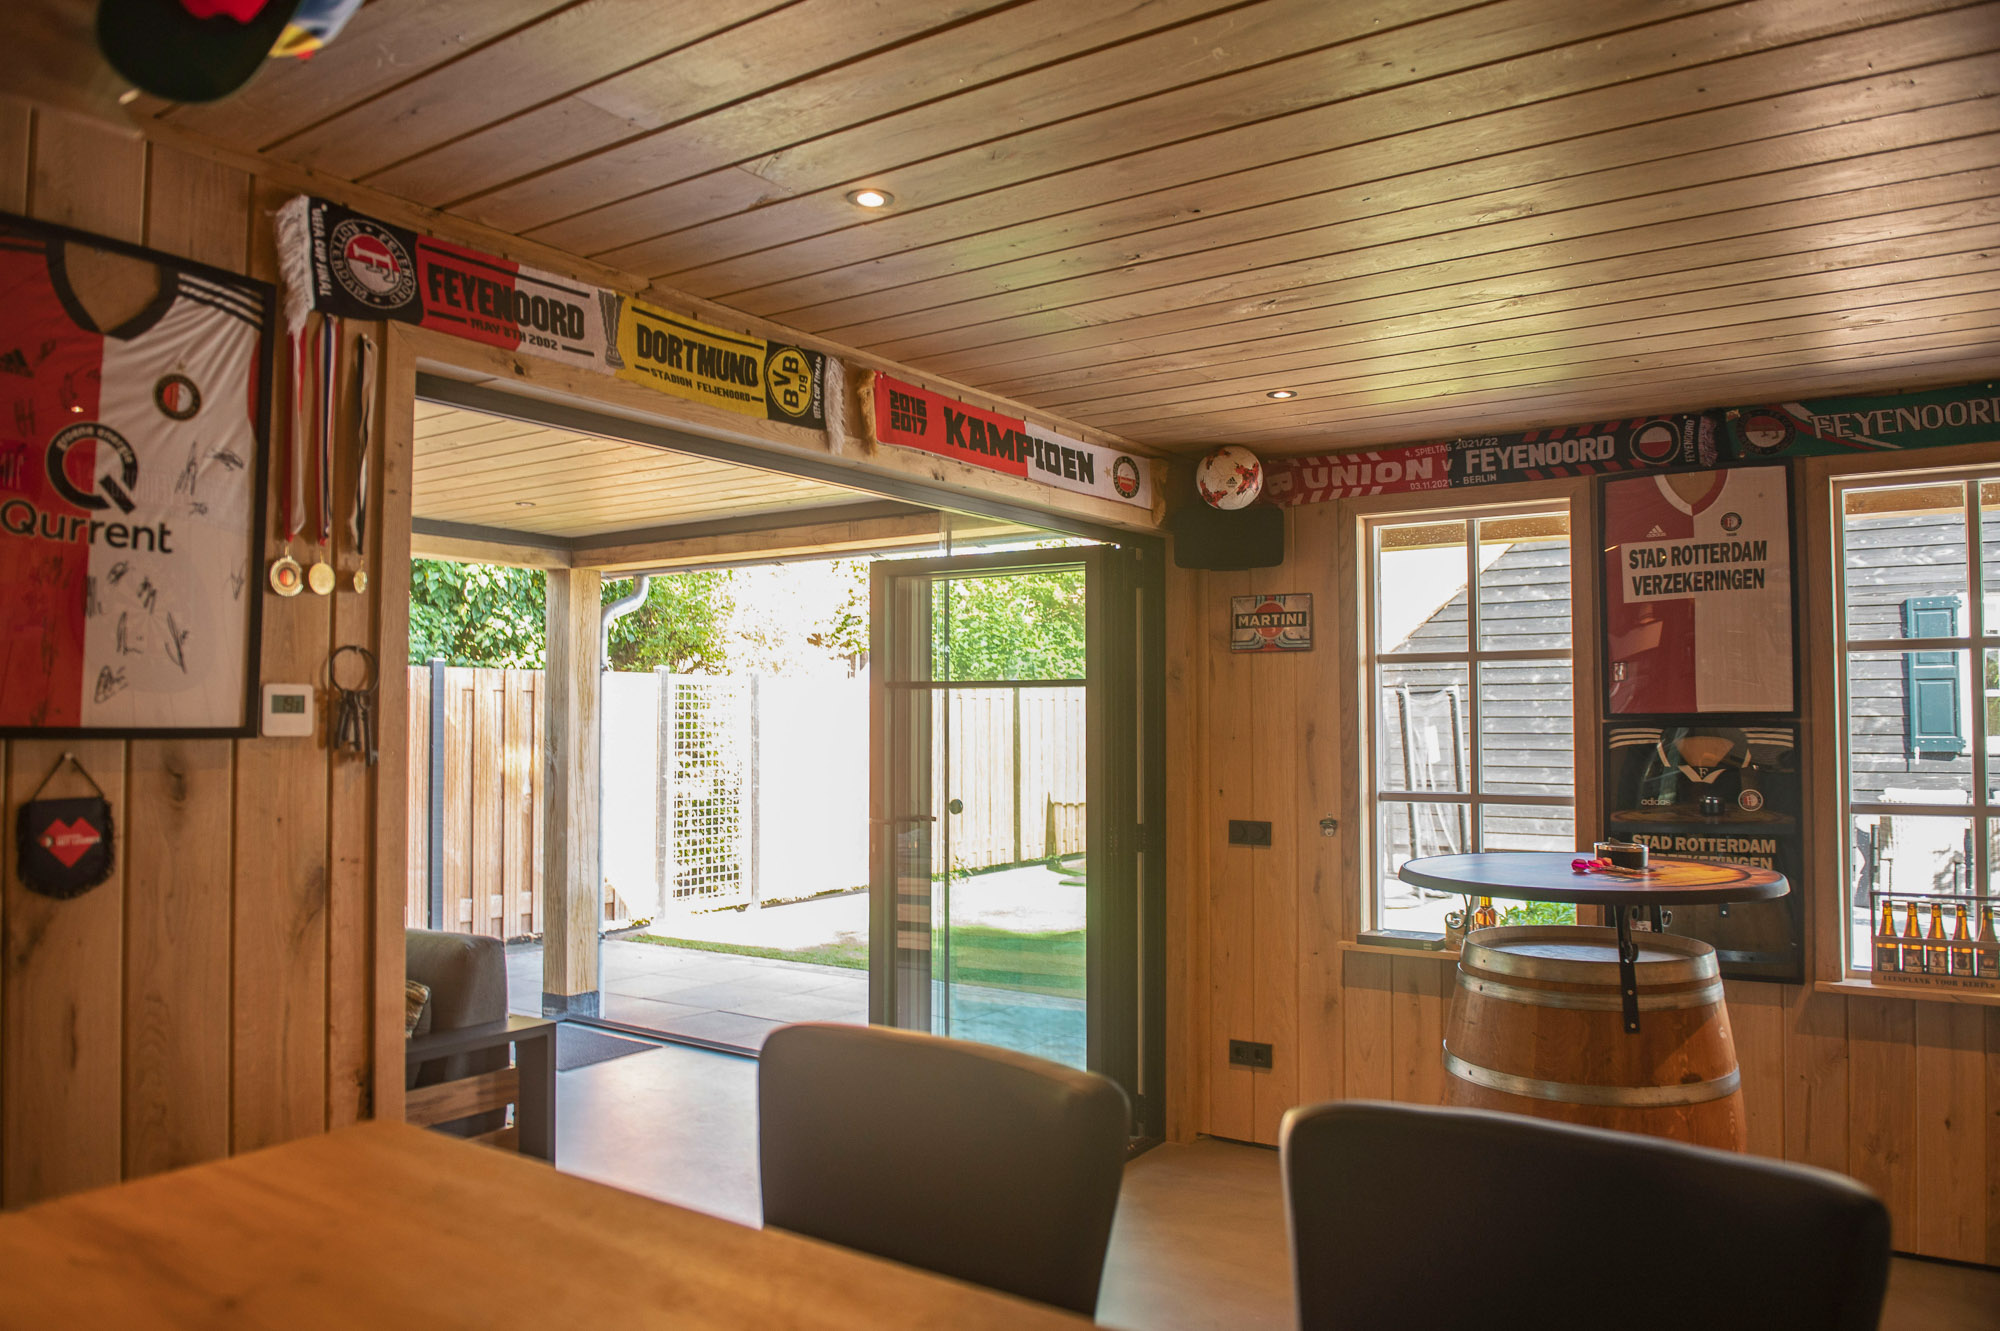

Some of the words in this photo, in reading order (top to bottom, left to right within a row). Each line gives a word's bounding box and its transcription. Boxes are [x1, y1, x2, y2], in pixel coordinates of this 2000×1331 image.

[427, 262, 585, 341] FEYENOORD
[470, 318, 500, 334] MAY
[528, 334, 559, 351] 2002
[636, 323, 759, 388] DORTMUND
[650, 368, 693, 389] STADION
[697, 381, 751, 403] FEIJENOORD
[772, 356, 800, 408] BVB
[889, 388, 928, 417] 2016
[890, 412, 928, 436] 2017
[943, 406, 1095, 485] KAMPIOEN
[1415, 443, 1452, 457] SPIELTAG
[1456, 437, 1498, 450] 2021/22
[1301, 457, 1433, 489] UNION
[1465, 435, 1615, 474] FEYENOORD
[1463, 473, 1497, 485] BERLIN
[1, 498, 172, 554] Qurrent
[1628, 549, 1667, 570] STAD
[1671, 540, 1768, 567] ROTTERDAM
[1631, 568, 1765, 597] VERZEKERINGEN
[1238, 613, 1303, 627] MARTINI
[1632, 834, 1673, 850] STAD
[1675, 836, 1777, 854] ROTTERDAM
